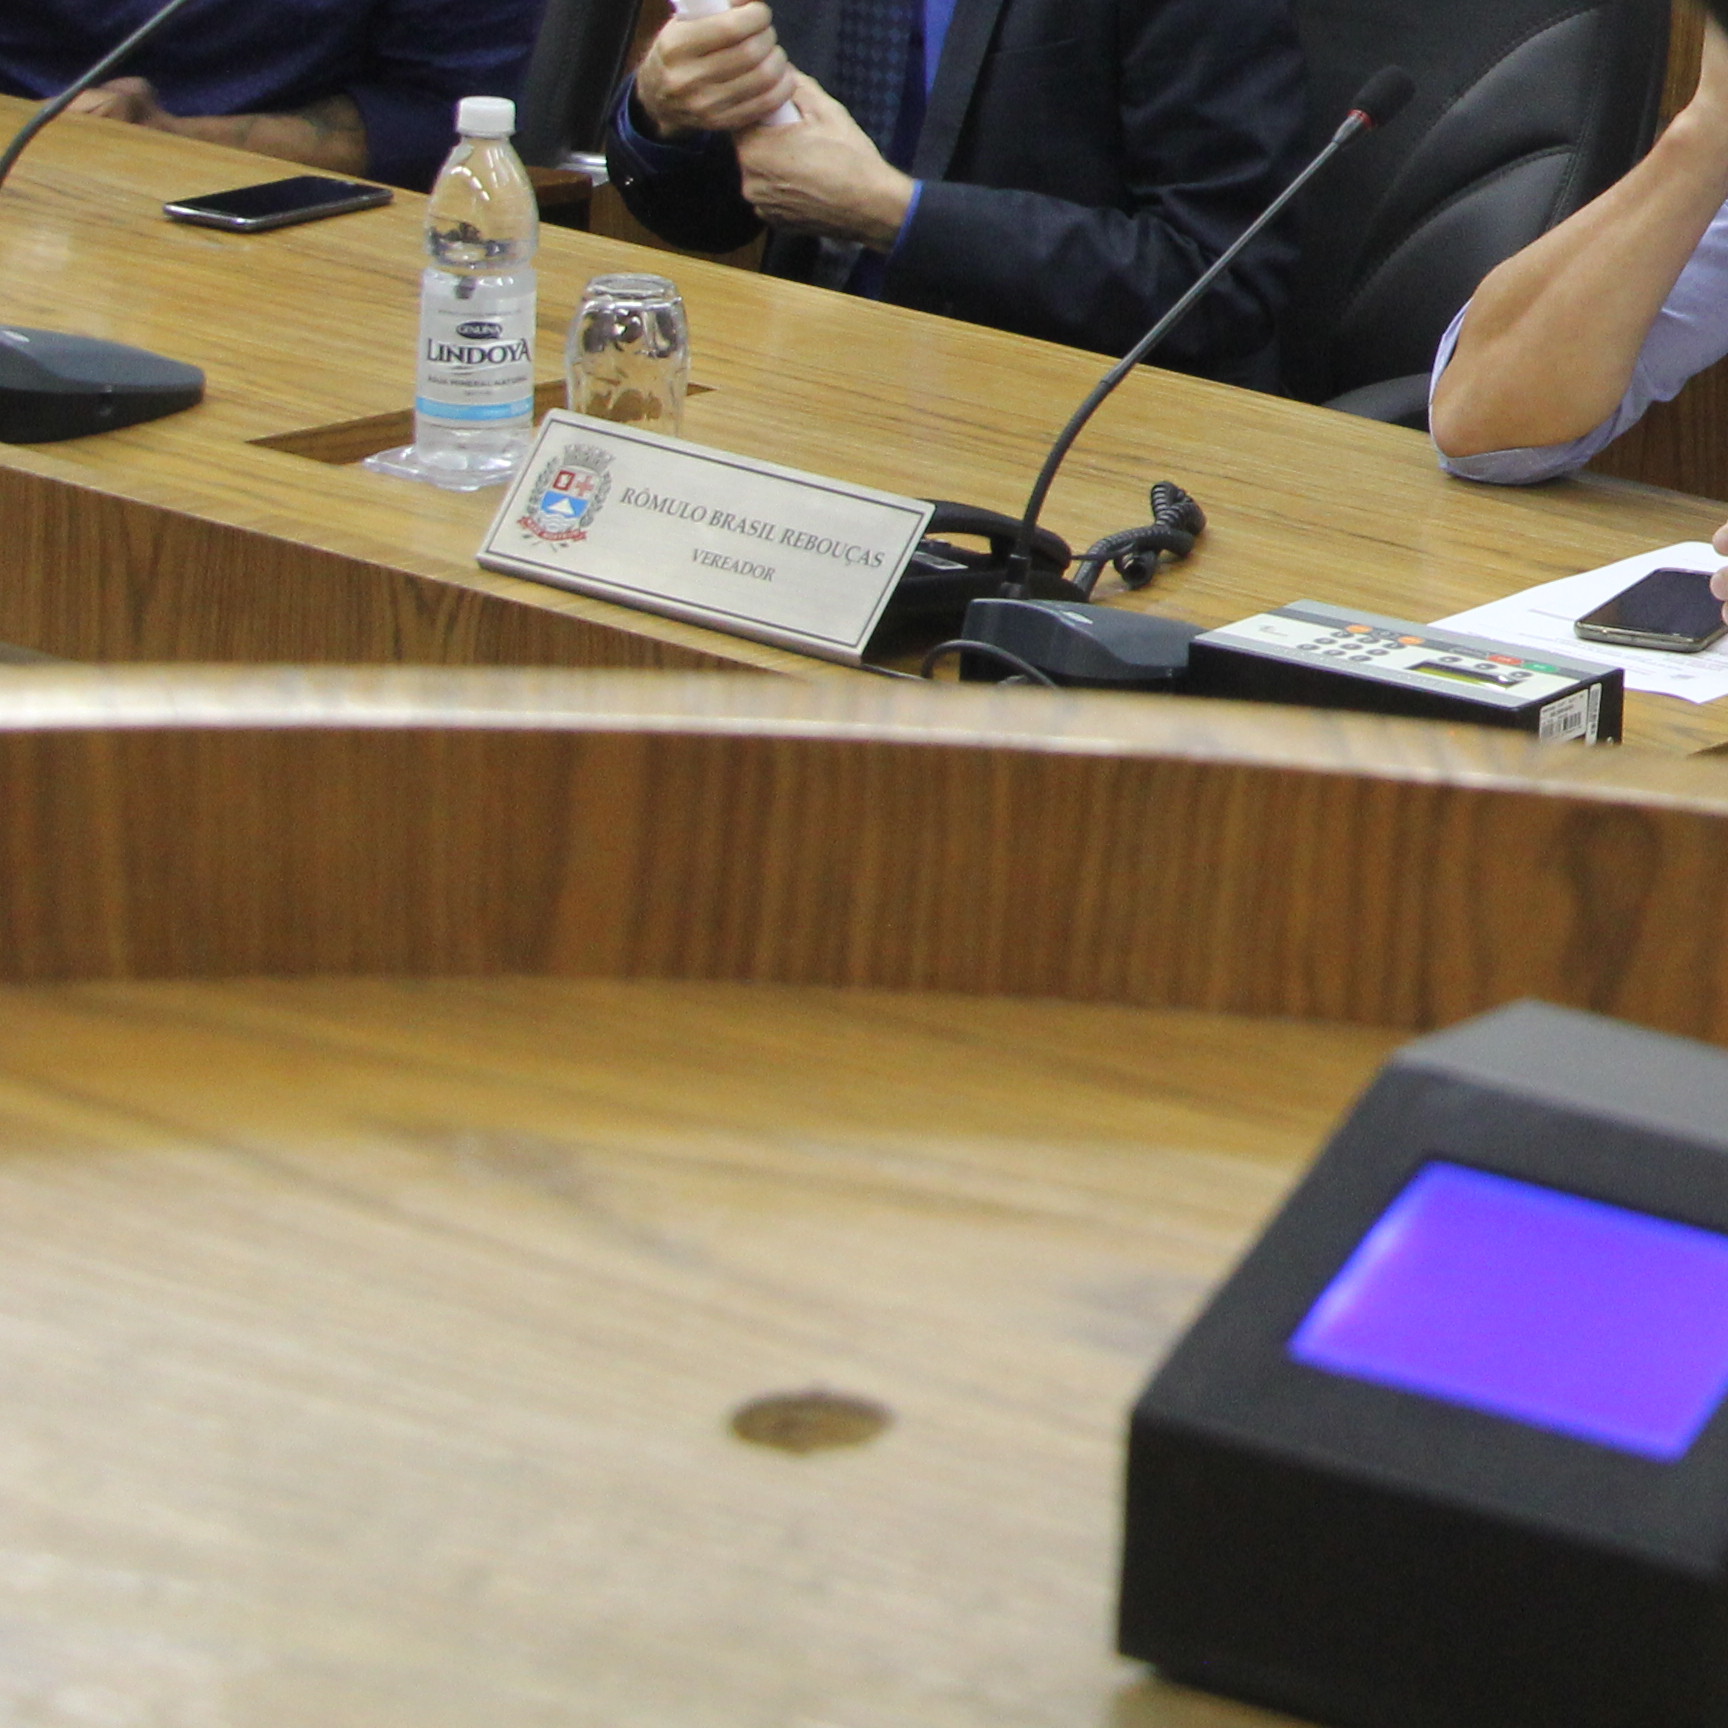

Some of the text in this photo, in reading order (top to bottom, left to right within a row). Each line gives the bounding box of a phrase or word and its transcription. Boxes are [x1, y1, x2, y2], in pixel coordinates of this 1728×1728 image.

[427, 338, 532, 364] LINDOYA
[620, 487, 886, 568] RÔMULO BRASIL REBOUÇAS
[692, 548, 777, 582] VEREADOR
